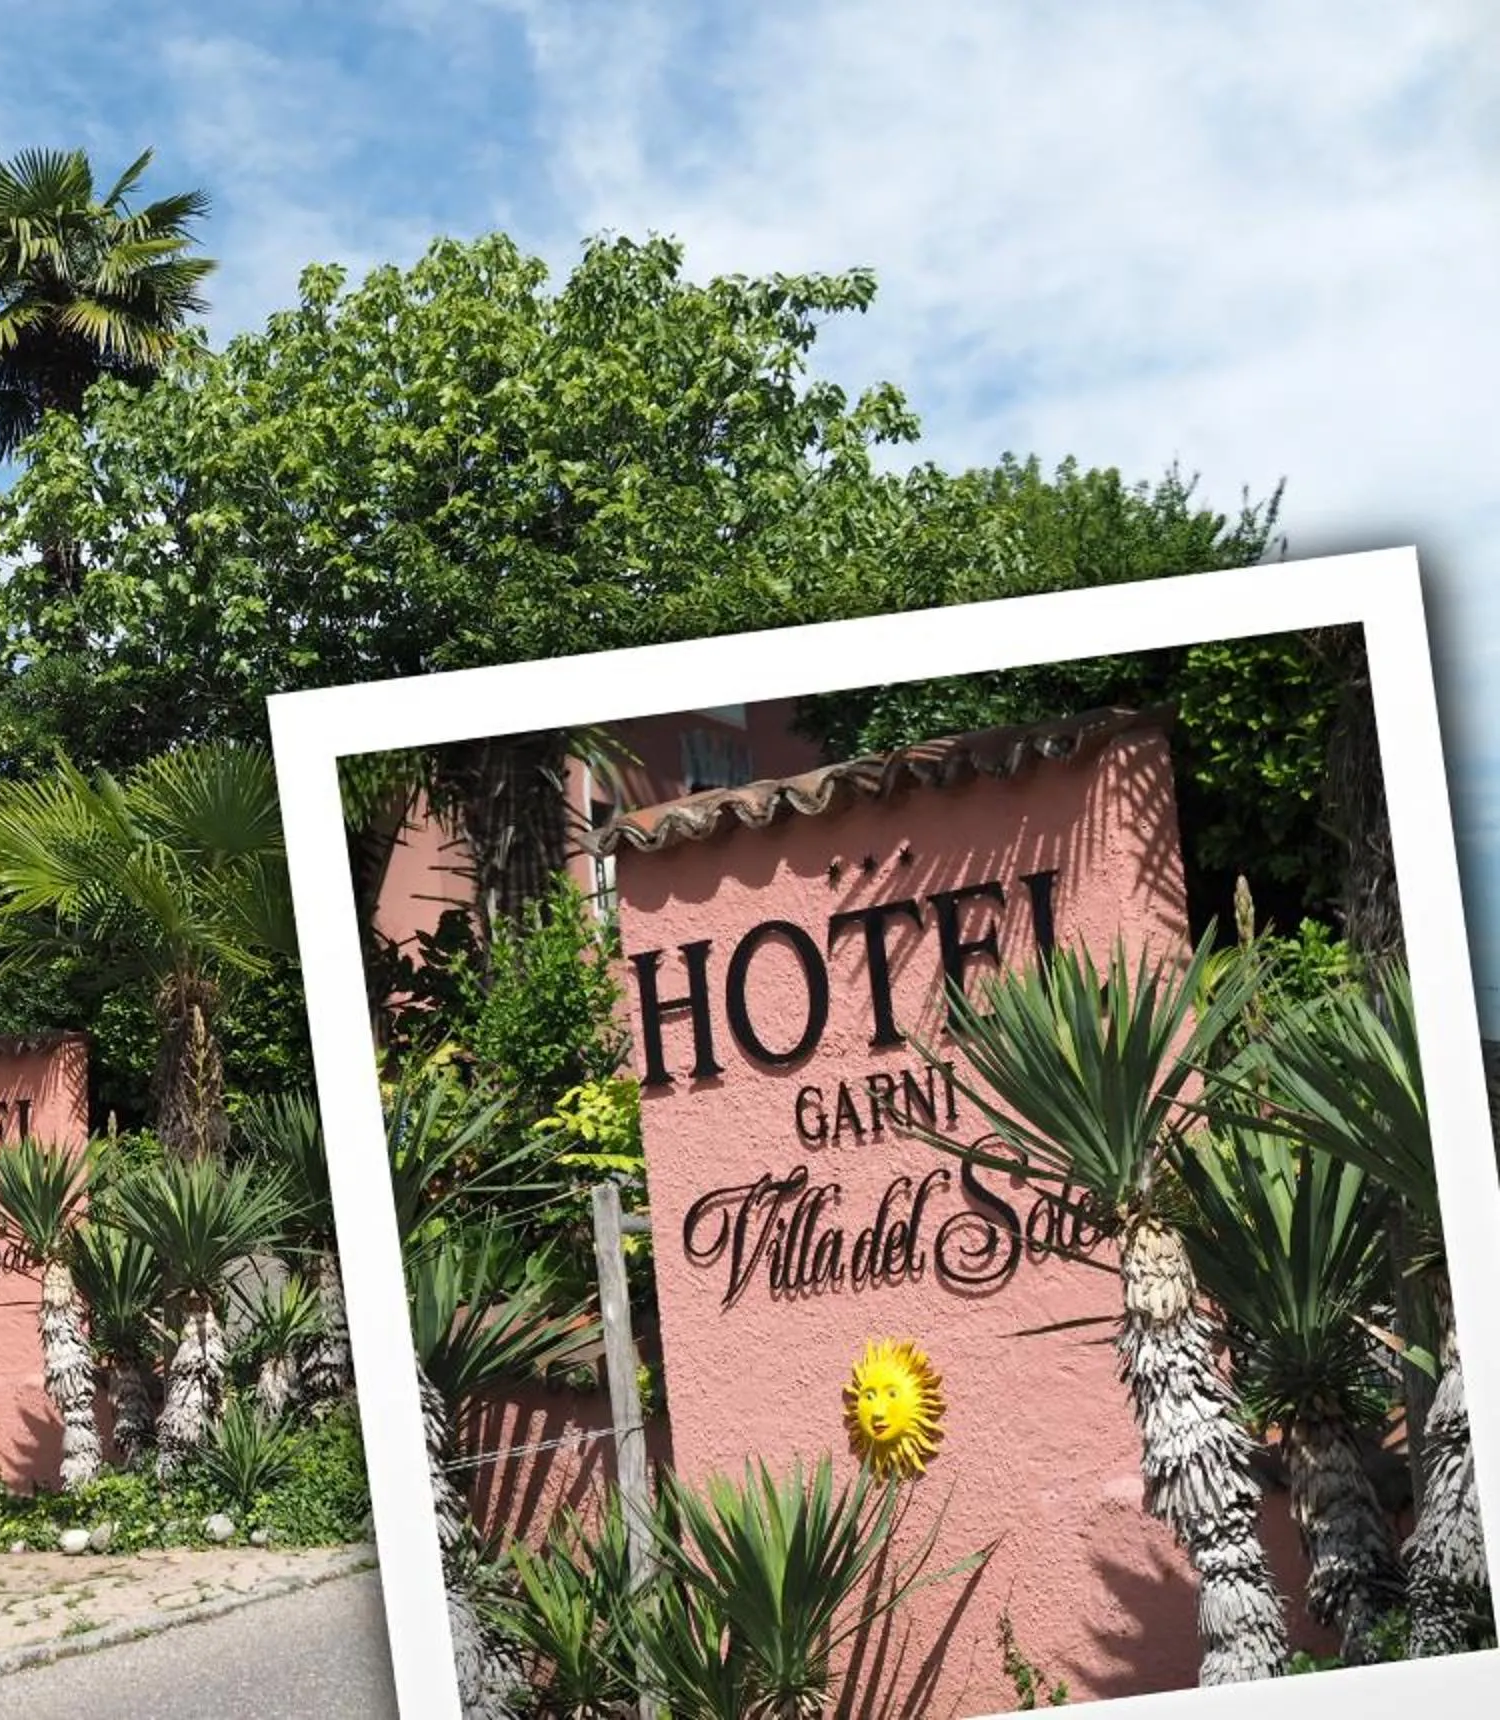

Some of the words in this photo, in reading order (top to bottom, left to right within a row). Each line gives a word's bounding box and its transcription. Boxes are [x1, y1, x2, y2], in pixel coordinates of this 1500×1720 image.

[794, 1060, 960, 1145] GARNI
[683, 1164, 846, 1306] Villa
[850, 1168, 951, 1286] del
